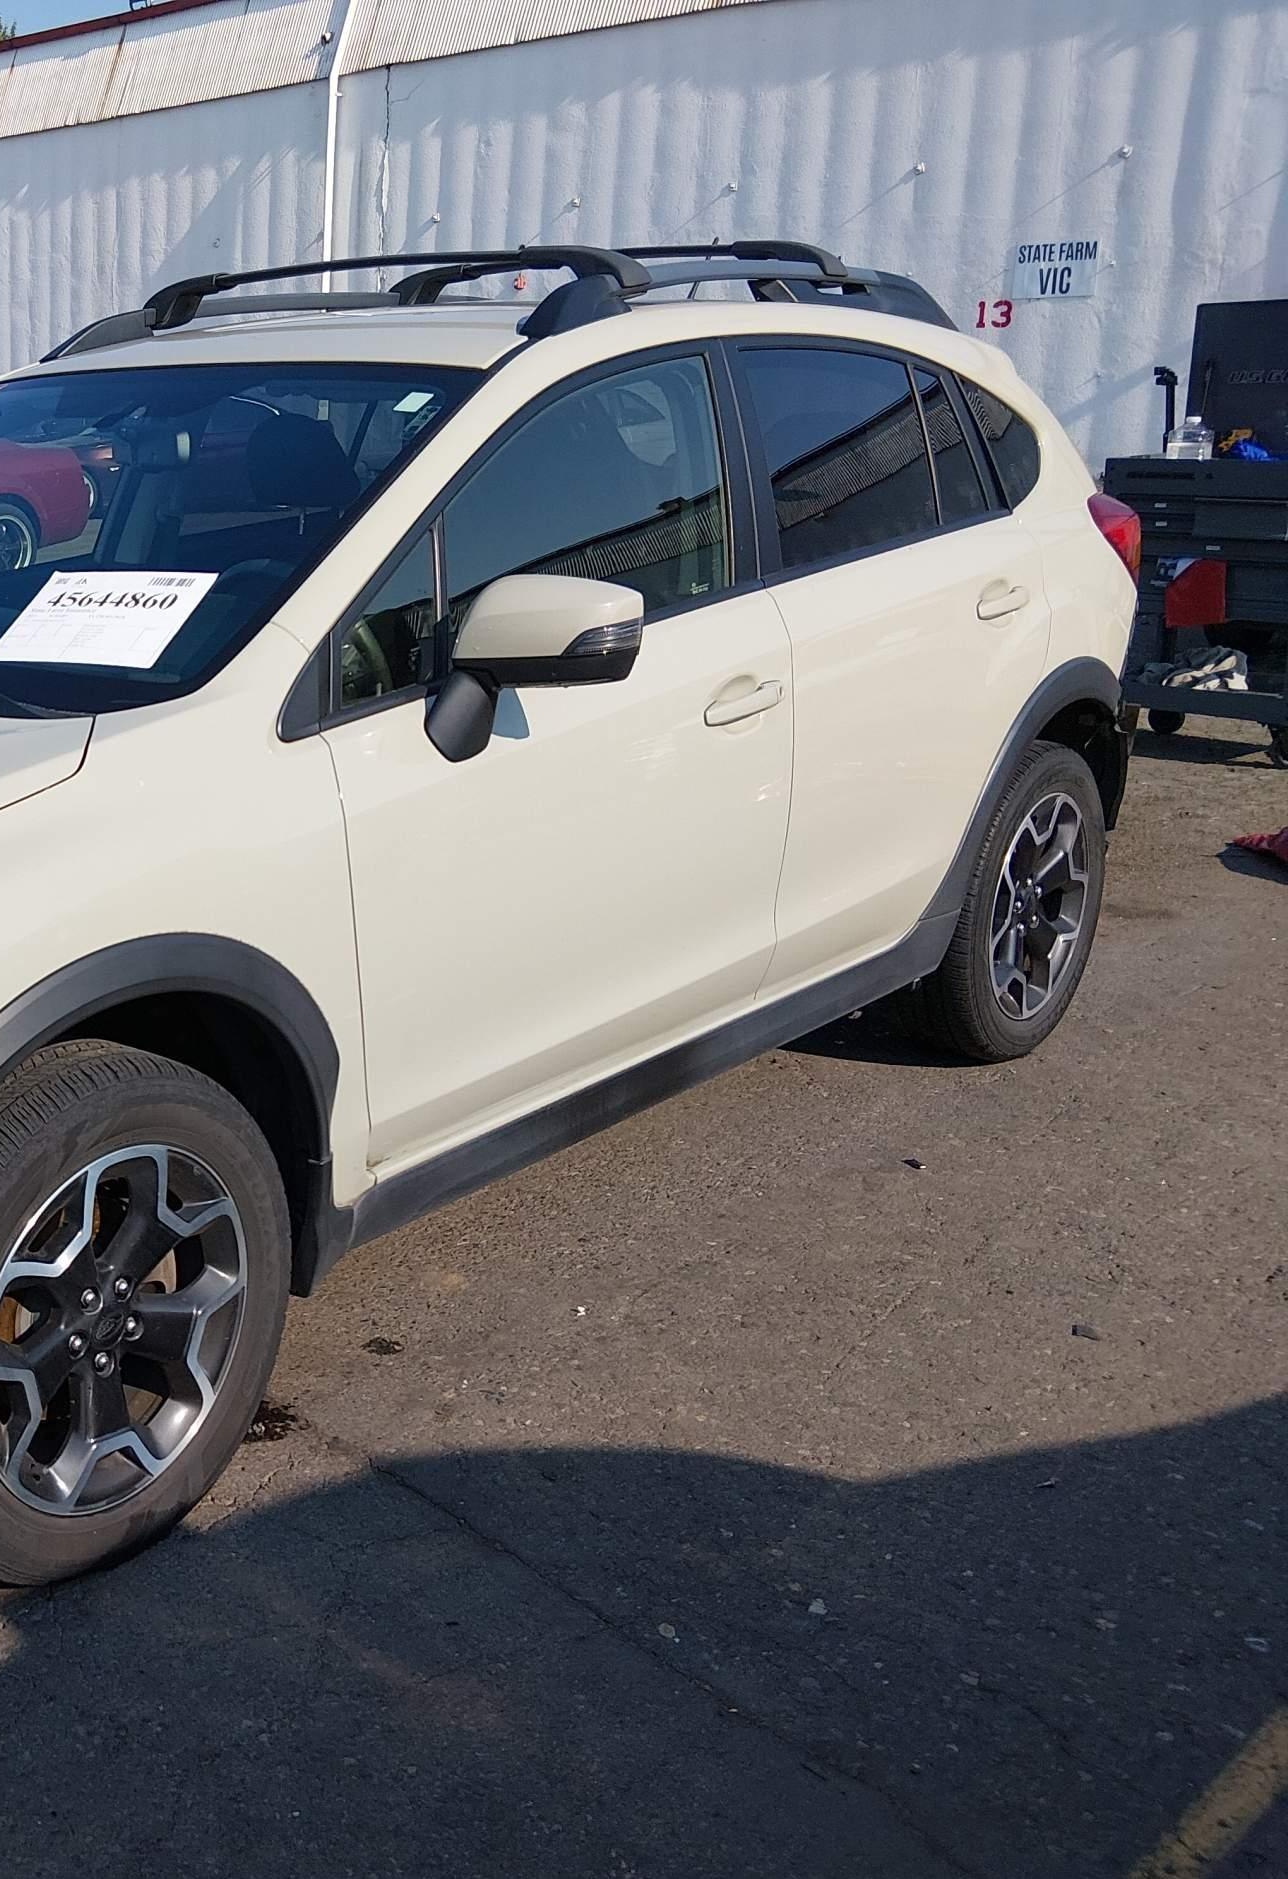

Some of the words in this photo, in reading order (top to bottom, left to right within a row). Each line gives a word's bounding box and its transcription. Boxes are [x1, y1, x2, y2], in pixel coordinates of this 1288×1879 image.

[1018, 243, 1055, 264] STATE
[1058, 241, 1098, 262] FARM
[1039, 266, 1072, 295] VIC
[975, 300, 1013, 329] 13
[47, 591, 179, 610] 45644860
